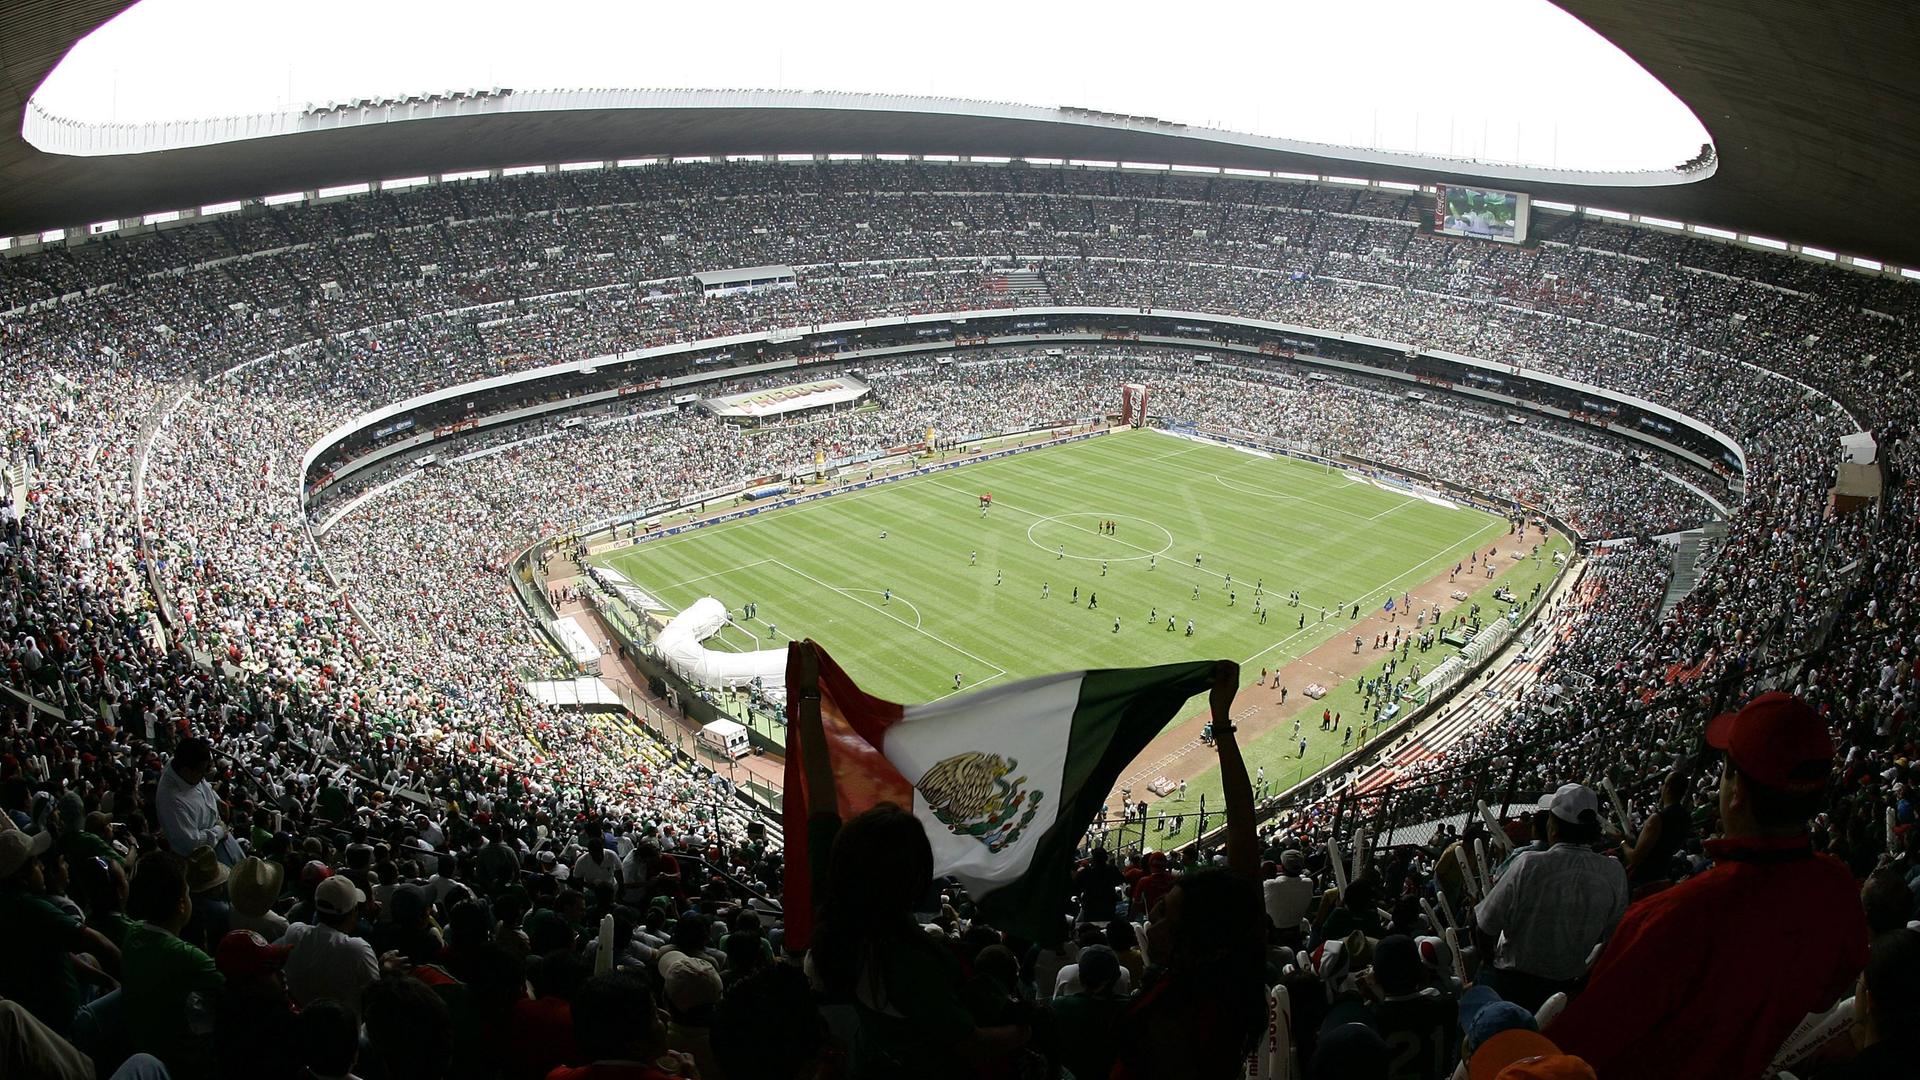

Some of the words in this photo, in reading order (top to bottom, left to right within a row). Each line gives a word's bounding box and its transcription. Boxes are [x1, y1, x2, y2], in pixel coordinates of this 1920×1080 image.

[730, 383, 844, 414] FREEDOM
[620, 509, 646, 521] PHILIPS
[1828, 1017, 1853, 1036] desde
[1384, 1026, 1443, 1080] 21
